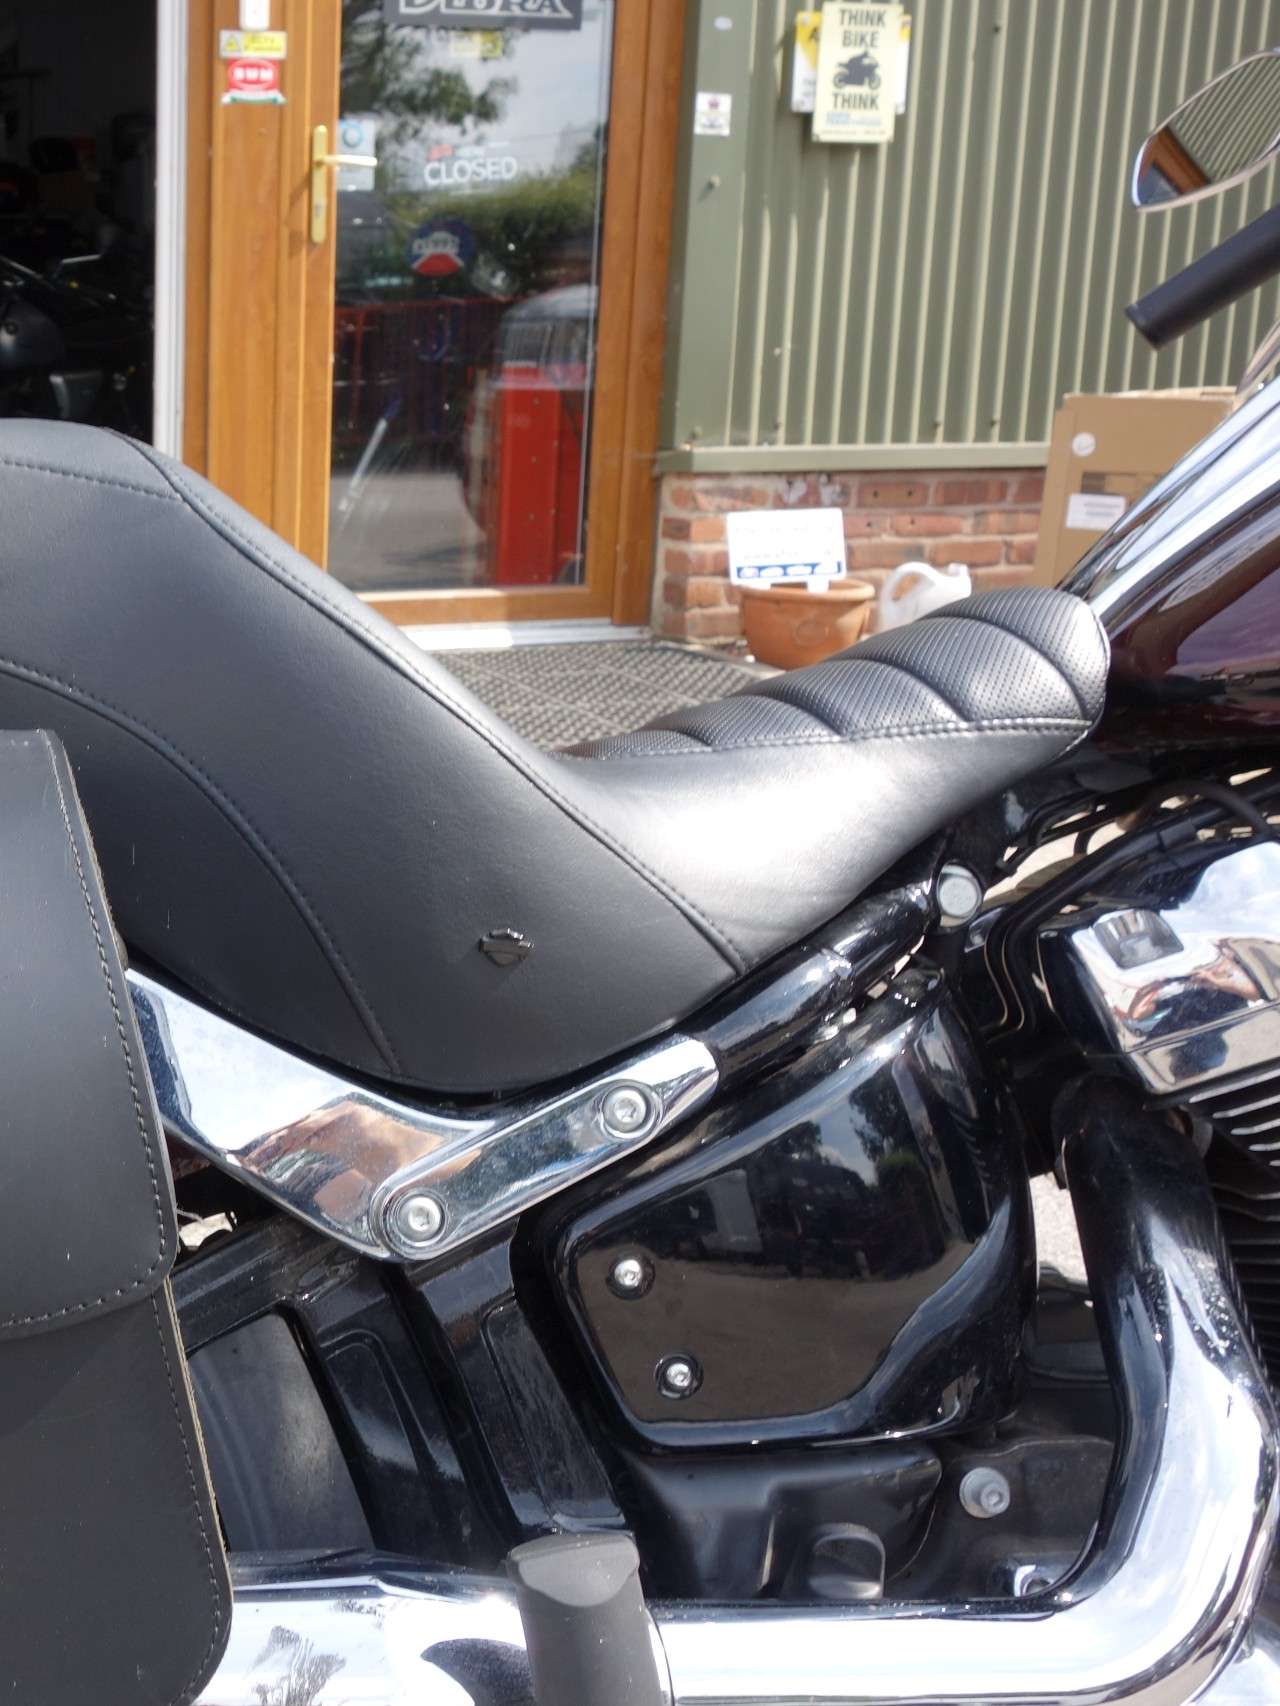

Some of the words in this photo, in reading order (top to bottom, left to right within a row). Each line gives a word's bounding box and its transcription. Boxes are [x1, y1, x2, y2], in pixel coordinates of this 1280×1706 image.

[839, 9, 886, 27] THINK
[842, 30, 879, 48] BIKE
[832, 93, 879, 111] THINK
[424, 156, 517, 187] CLOSED
